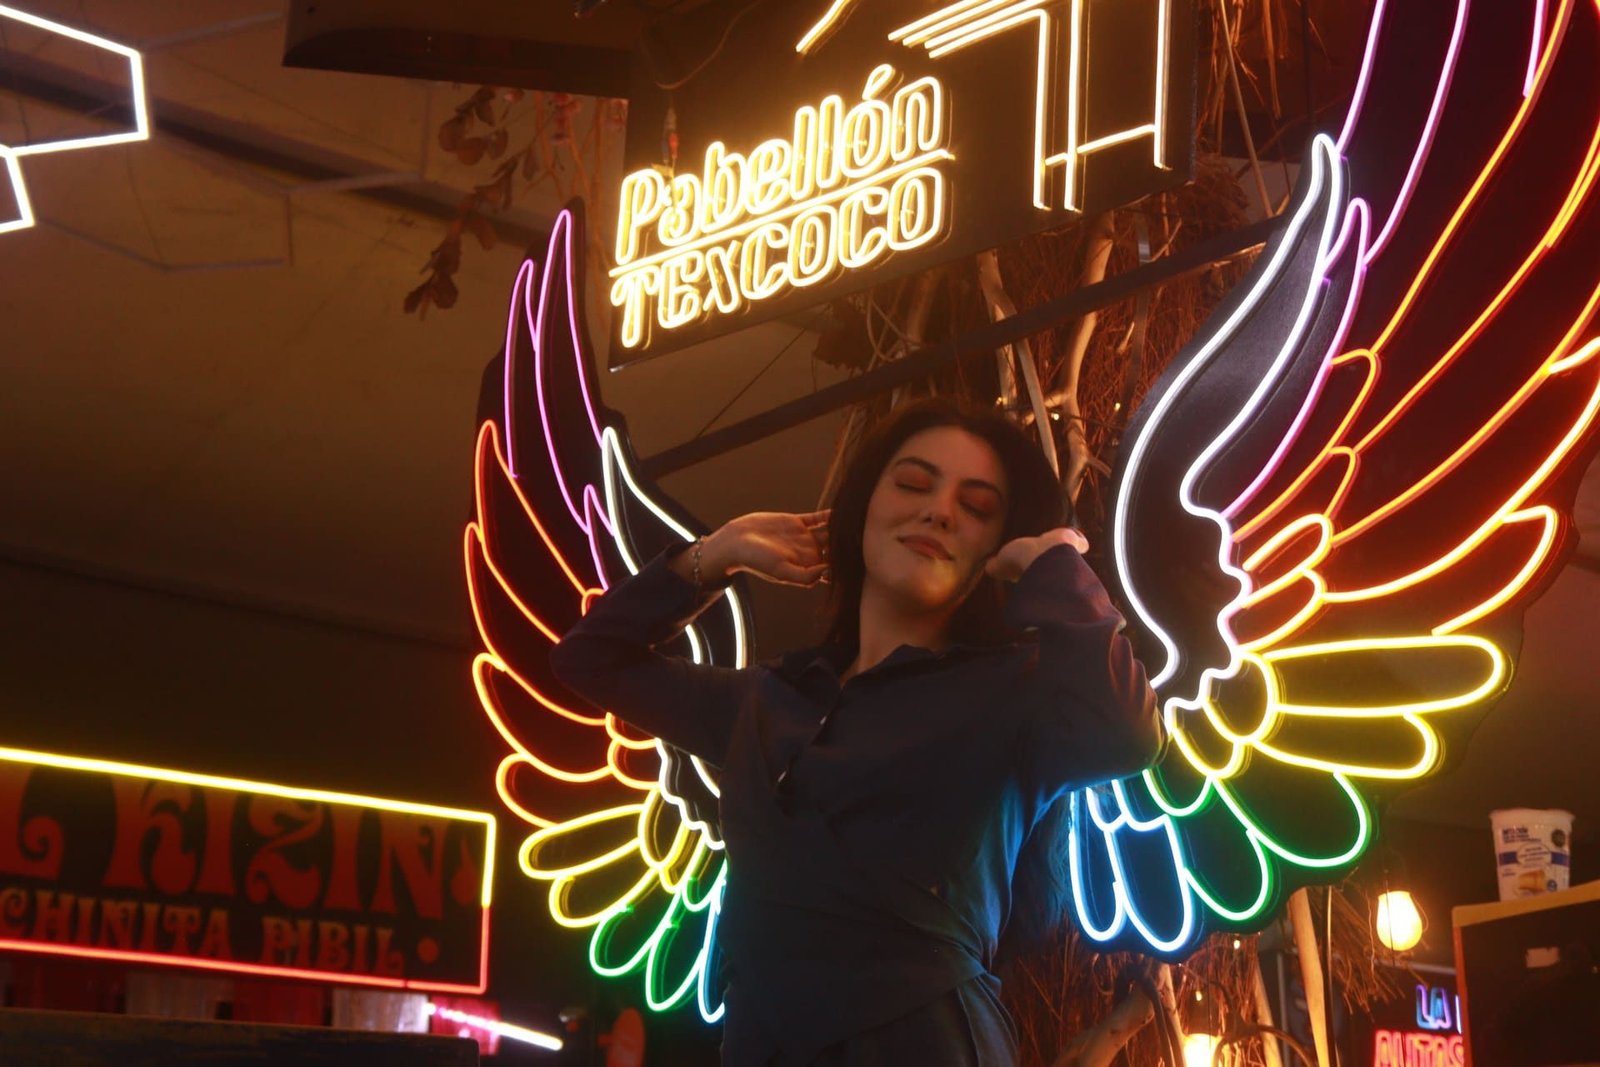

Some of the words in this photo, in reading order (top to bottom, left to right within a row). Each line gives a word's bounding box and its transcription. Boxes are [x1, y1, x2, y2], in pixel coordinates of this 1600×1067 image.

[615, 63, 942, 266] Pabellón
[610, 166, 944, 349] TEXCOCO
[101, 774, 446, 920] KIZIN
[258, 915, 405, 979] PIBIL
